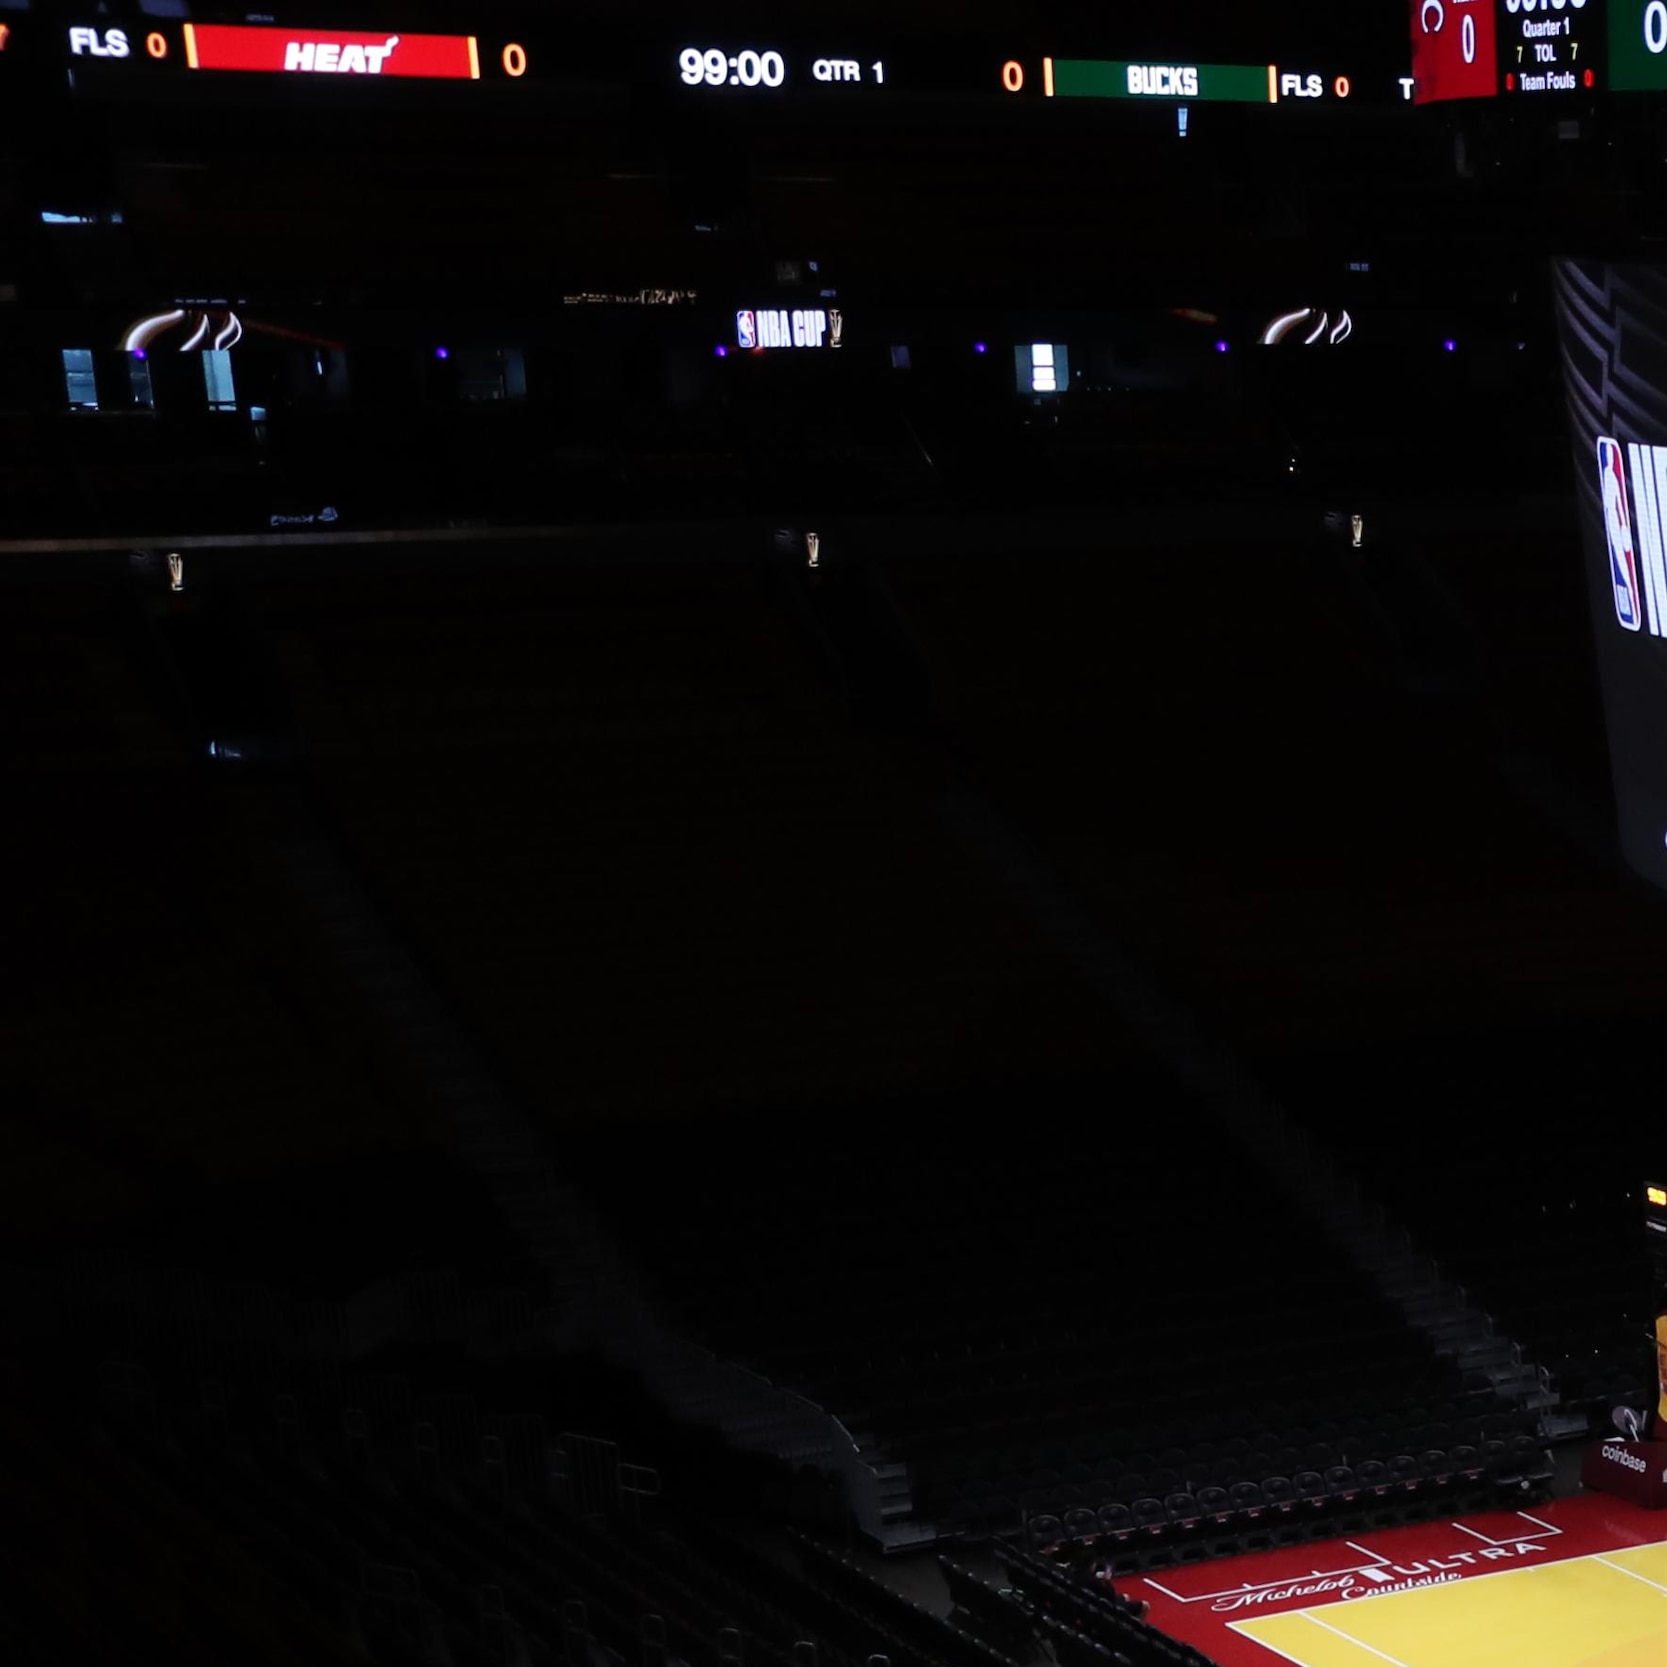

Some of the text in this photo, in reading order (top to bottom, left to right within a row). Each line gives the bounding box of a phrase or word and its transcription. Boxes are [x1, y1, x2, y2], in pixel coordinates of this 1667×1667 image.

[69, 27, 168, 59] FLS 0
[1462, 14, 1475, 64] 0
[1523, 16, 1570, 38] Quarter 1
[284, 36, 399, 73] HEAT
[503, 43, 526, 76] 0
[679, 48, 784, 87] 99:00
[1517, 43, 1578, 63] 7 TOL 7
[812, 59, 884, 84] QTR 1
[1002, 60, 1024, 92] 0
[1127, 65, 1198, 96] BUCKS
[1281, 74, 1350, 98] FLS 0
[1520, 73, 1546, 91] Team
[1547, 72, 1576, 90] Fouls
[756, 310, 827, 347] NBA CUP
[1602, 1445, 1647, 1473] coinbase
[1211, 1542, 1547, 1611] Michelob ULTRA
